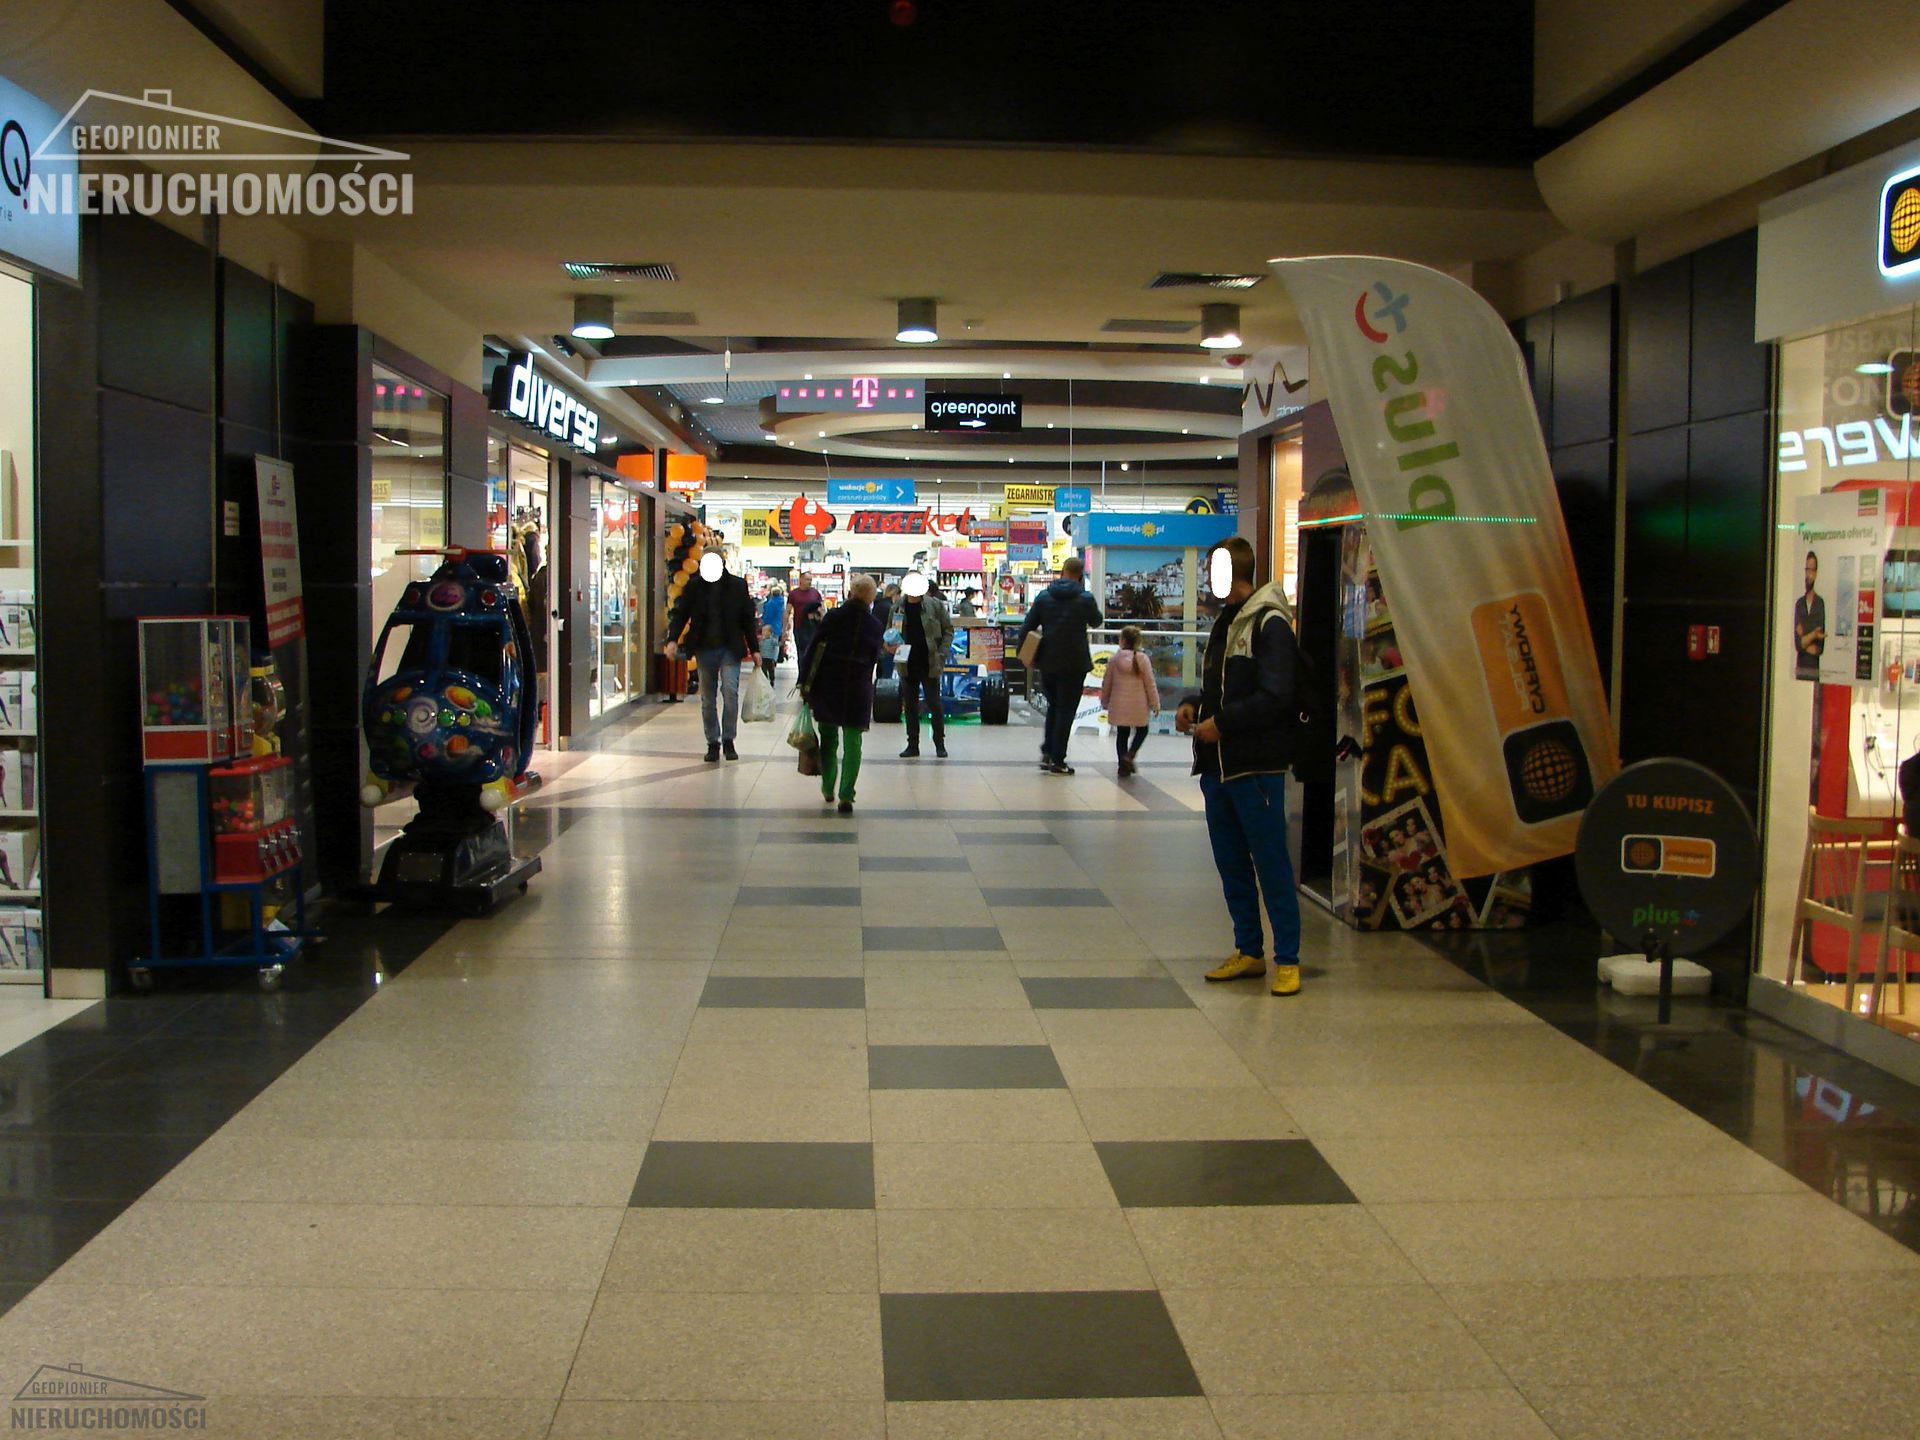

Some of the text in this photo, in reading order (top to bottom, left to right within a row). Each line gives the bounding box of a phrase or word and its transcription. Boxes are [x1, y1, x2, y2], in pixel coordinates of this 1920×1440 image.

[509, 351, 599, 454] diverse
[931, 400, 1016, 418] greenpoint
[1007, 487, 1056, 501] ZEGARMISTR
[744, 519, 767, 528] BLACK
[847, 506, 971, 536] market
[744, 528, 767, 537] FRIDAY
[1625, 794, 1715, 815] TU KUPISZ
[1631, 903, 1681, 927] plus
